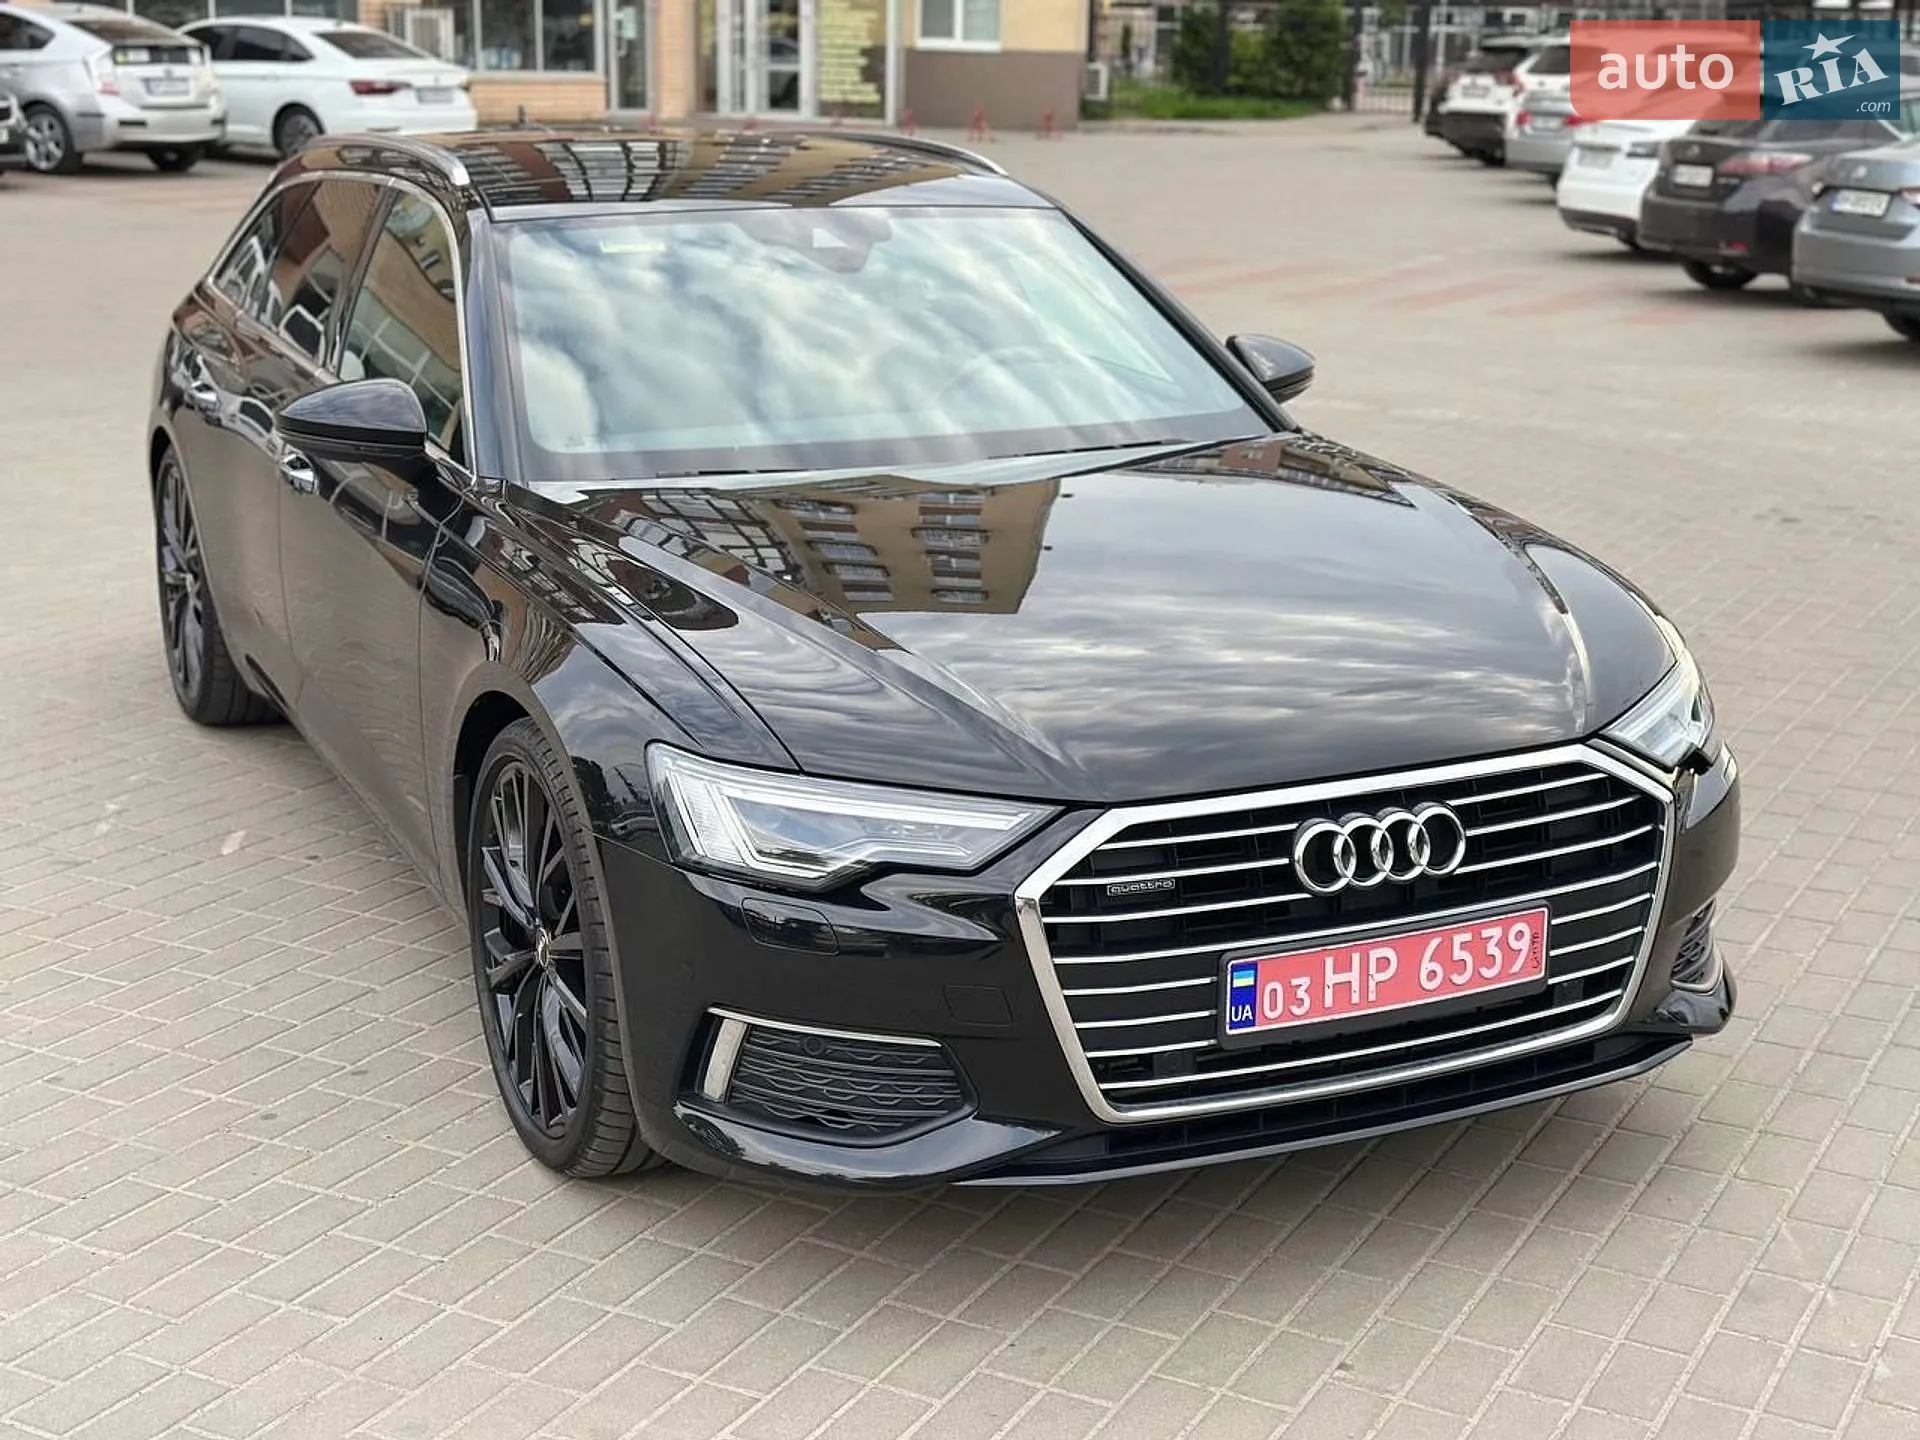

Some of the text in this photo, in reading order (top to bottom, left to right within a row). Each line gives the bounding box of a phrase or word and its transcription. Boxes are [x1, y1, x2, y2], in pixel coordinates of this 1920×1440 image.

[1110, 879, 1174, 896] quattro
[1419, 921, 1531, 991] 6539
[1231, 1004, 1254, 1022] UA
